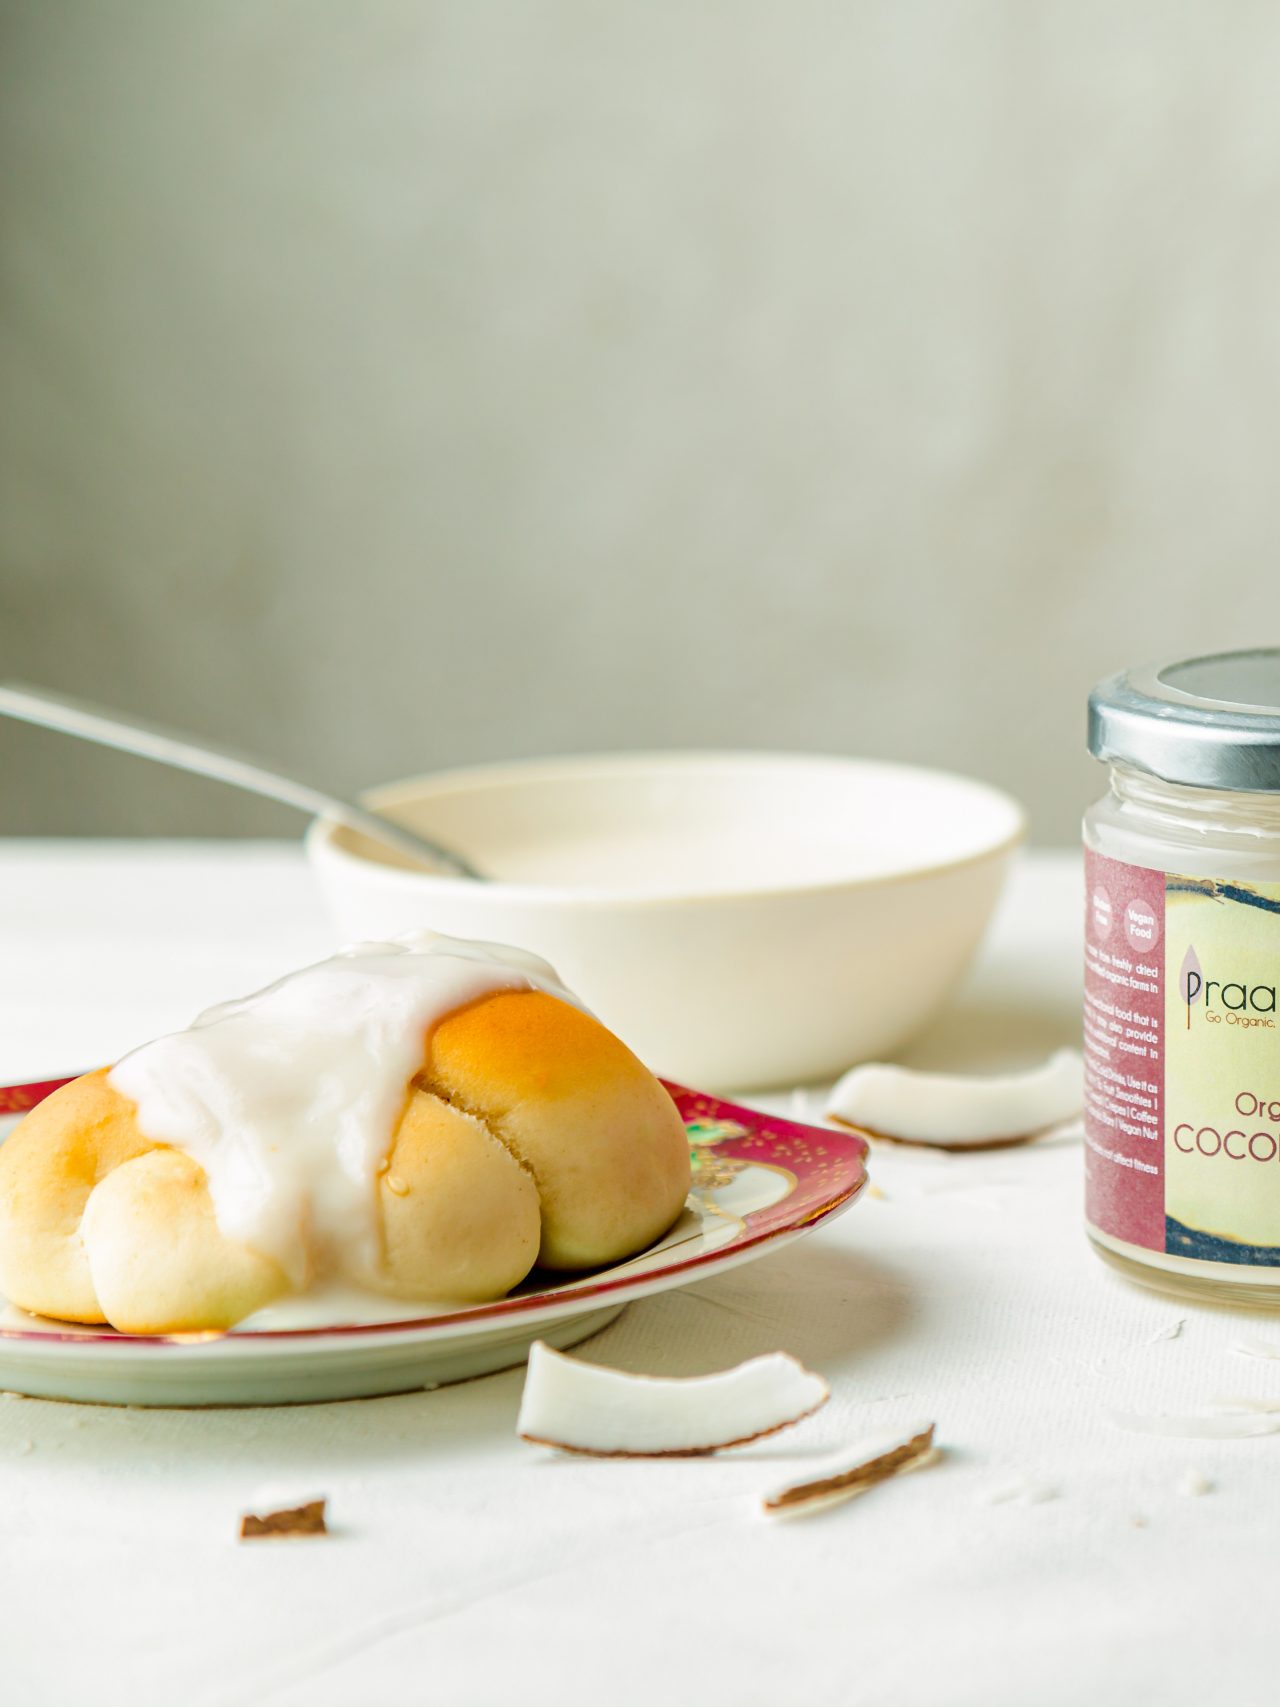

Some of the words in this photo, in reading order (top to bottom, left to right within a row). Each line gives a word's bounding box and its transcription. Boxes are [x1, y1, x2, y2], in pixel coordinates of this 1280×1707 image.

[1128, 909, 1154, 926] Vegan
[1129, 924, 1152, 939] Food
[1136, 963, 1158, 978] dried
[1130, 977, 1149, 991] farms
[1151, 982, 1158, 994] in
[1133, 1012, 1149, 1026] that
[1152, 1017, 1158, 1028] is
[1206, 1010, 1222, 1024] Go
[1126, 1028, 1158, 1044] provide
[1119, 1041, 1147, 1057] content
[1150, 1048, 1158, 1060] in
[1148, 1084, 1158, 1094] as
[1130, 1109, 1158, 1125] Coffee
[1119, 1120, 1142, 1137] Vegan
[1142, 1127, 1158, 1141] Nut
